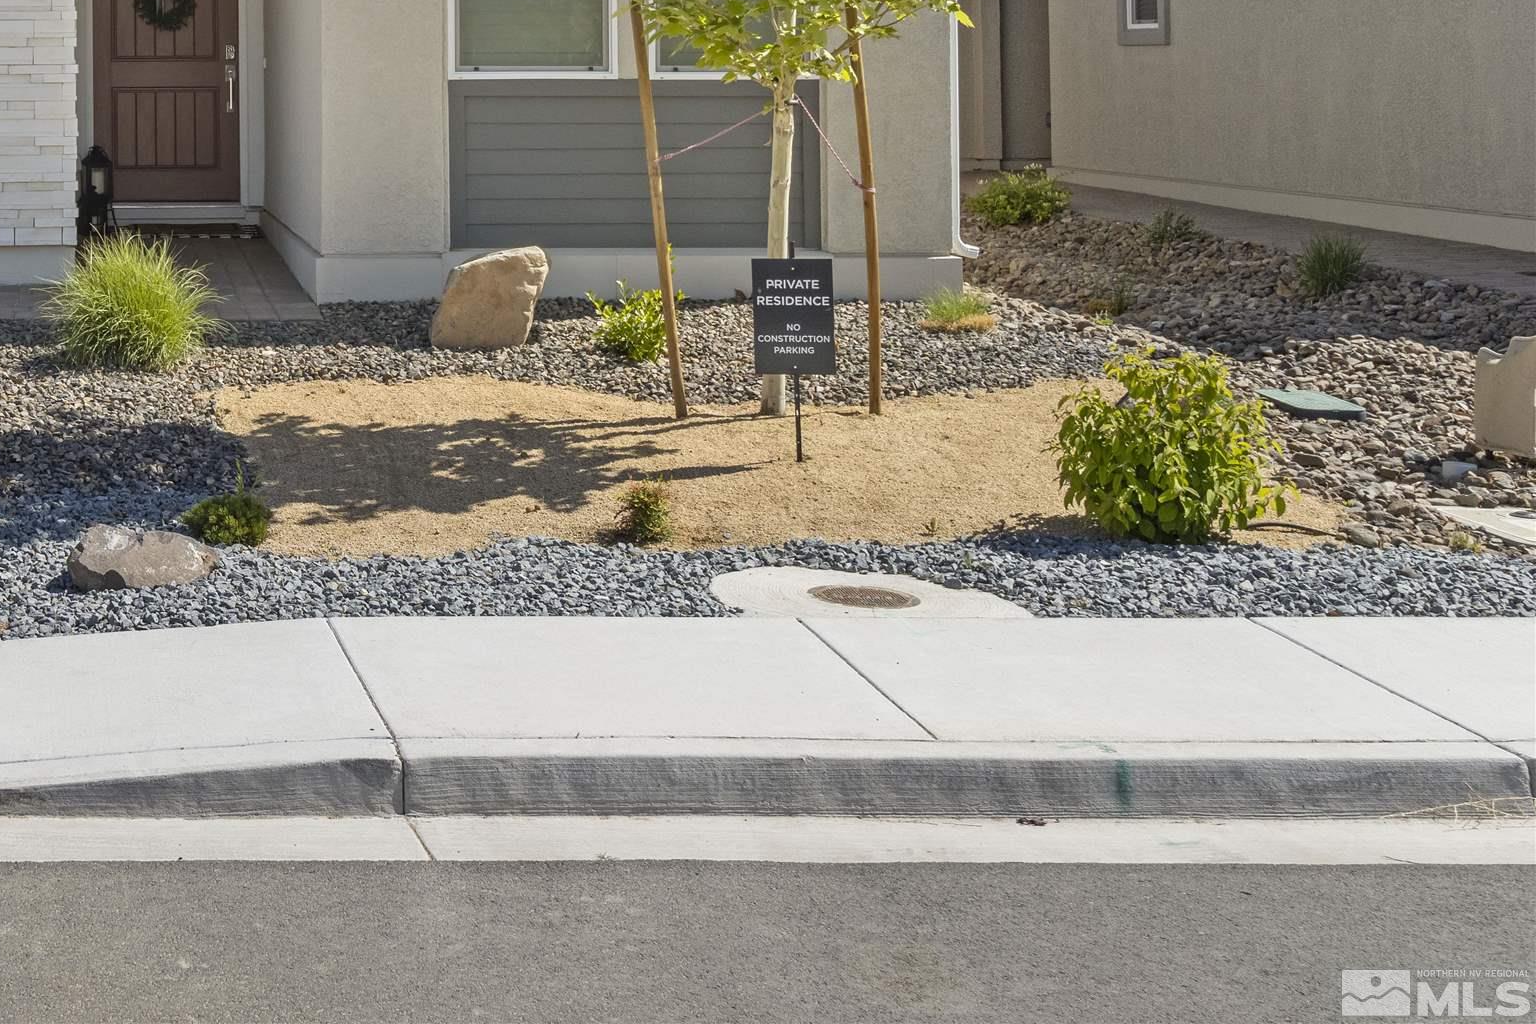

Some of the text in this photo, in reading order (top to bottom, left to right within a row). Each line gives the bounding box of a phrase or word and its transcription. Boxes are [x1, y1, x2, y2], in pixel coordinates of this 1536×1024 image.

[766, 279, 820, 289] PRIVATE
[756, 296, 830, 306] RESIDENCE
[786, 323, 801, 331] NO
[757, 334, 831, 343] CONSTRUCTION
[773, 346, 815, 354] PARKING
